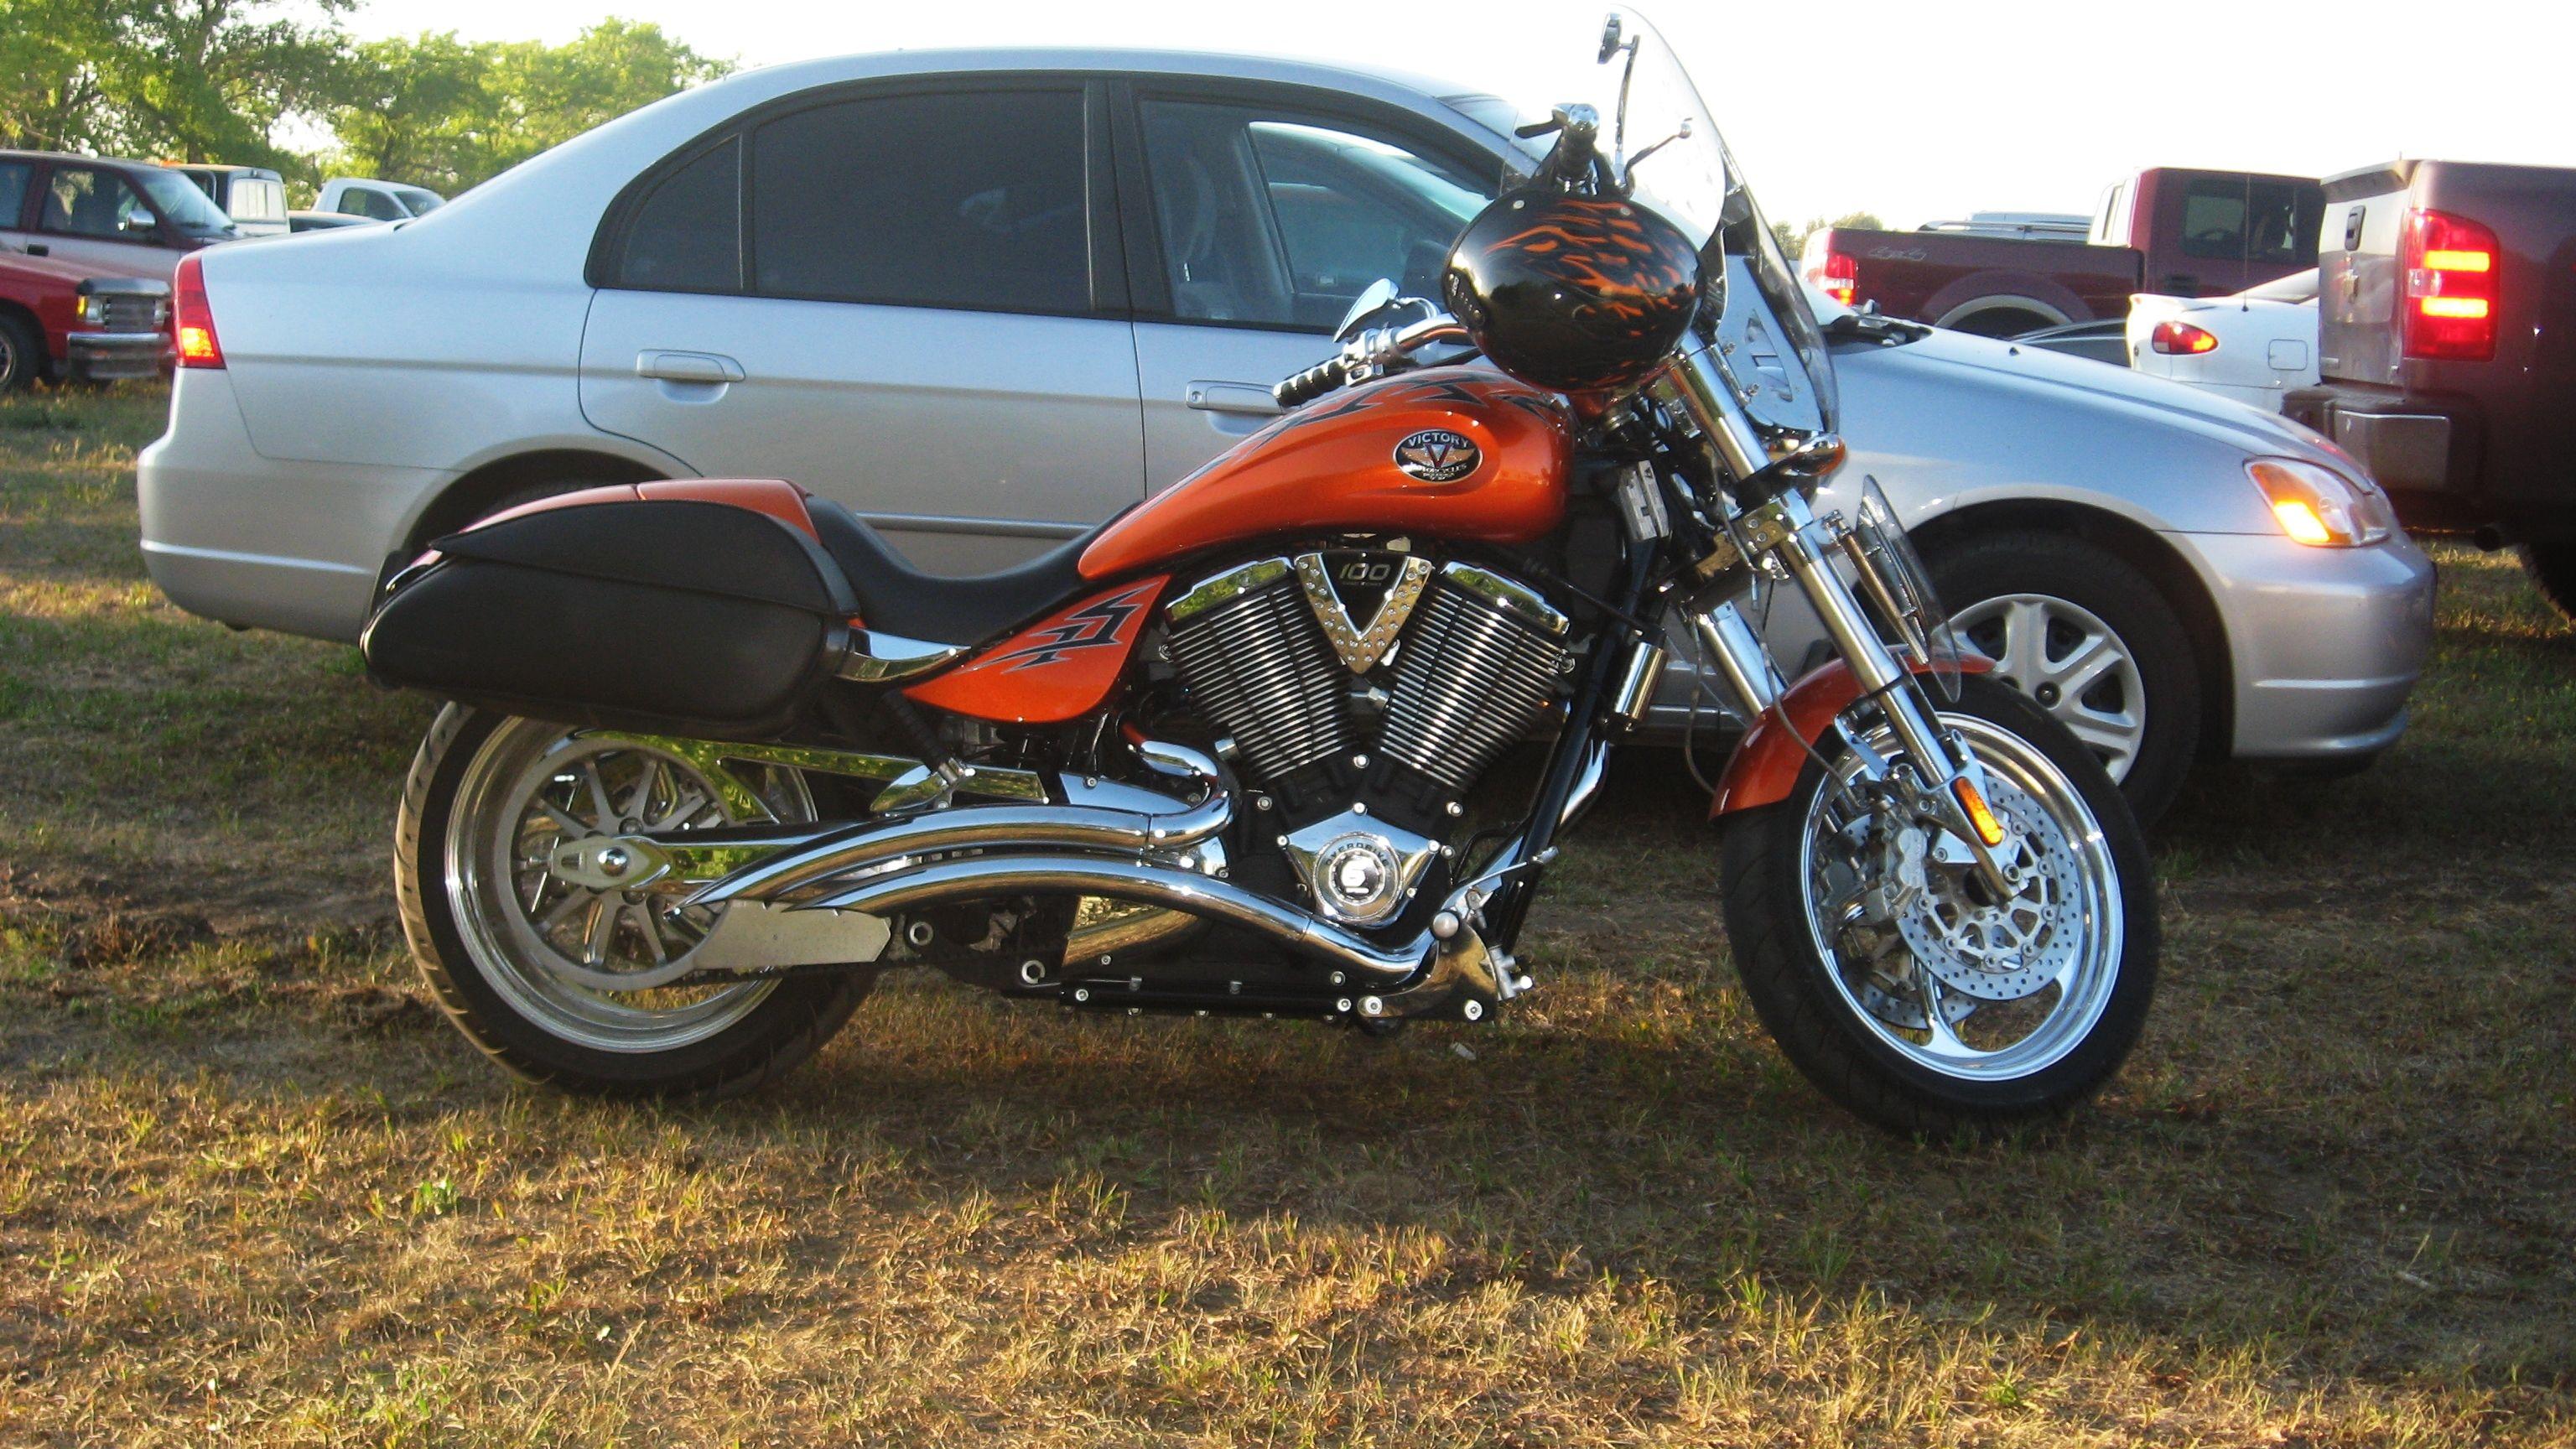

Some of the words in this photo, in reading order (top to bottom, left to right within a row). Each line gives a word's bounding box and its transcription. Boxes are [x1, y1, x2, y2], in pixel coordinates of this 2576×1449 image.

[1409, 432, 1469, 448] VICTORY
[1339, 563, 1391, 580] 100
[1327, 842, 1389, 866] OVERDRIVE
